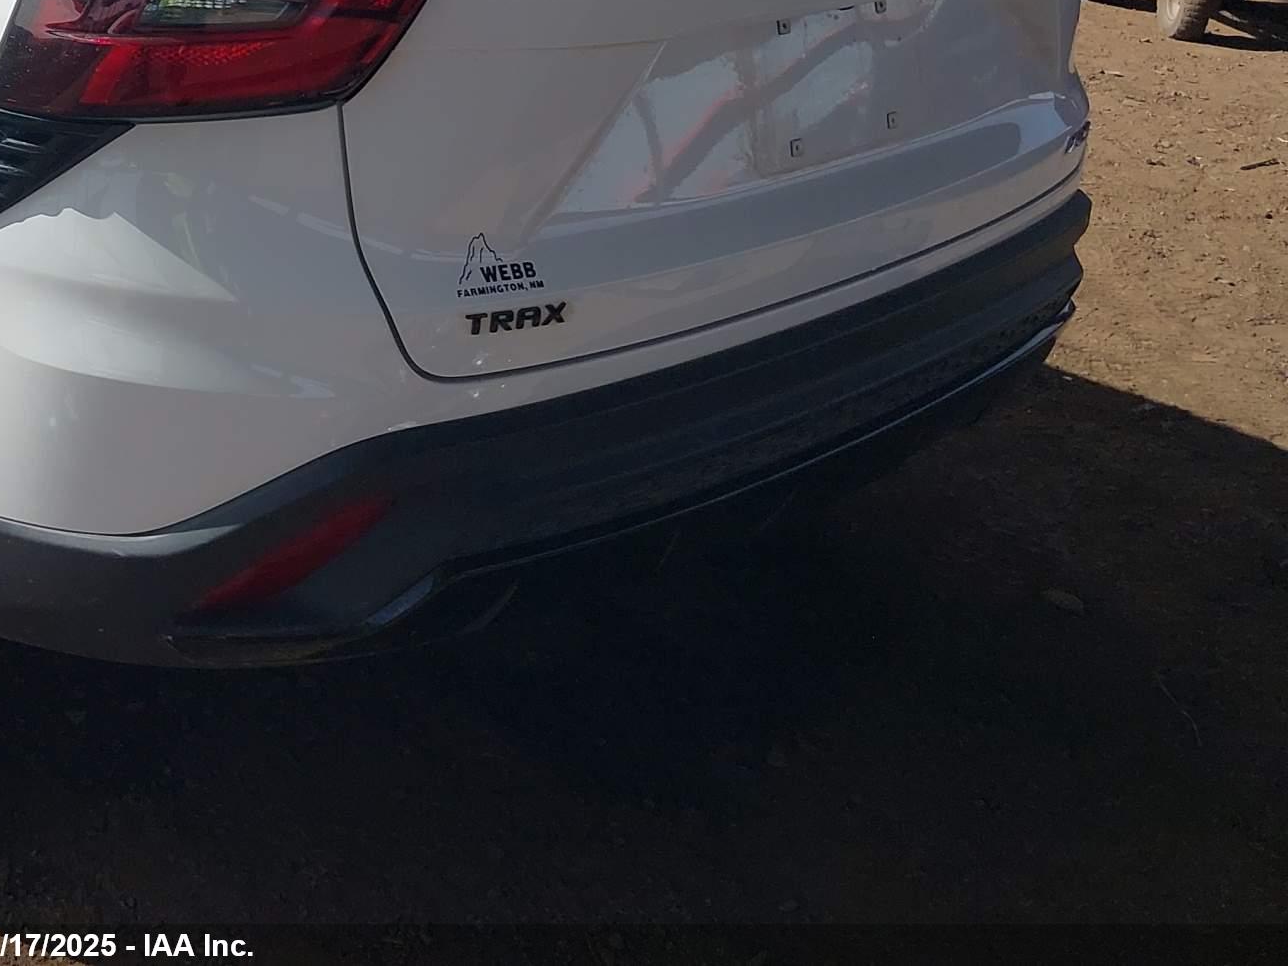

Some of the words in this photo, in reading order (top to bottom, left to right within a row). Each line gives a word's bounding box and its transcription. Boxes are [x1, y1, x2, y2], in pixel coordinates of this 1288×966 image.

[480, 262, 537, 283] WEBB
[457, 282, 528, 298] FARMINGTON,
[529, 280, 544, 289] NM
[465, 301, 566, 335] TRAX
